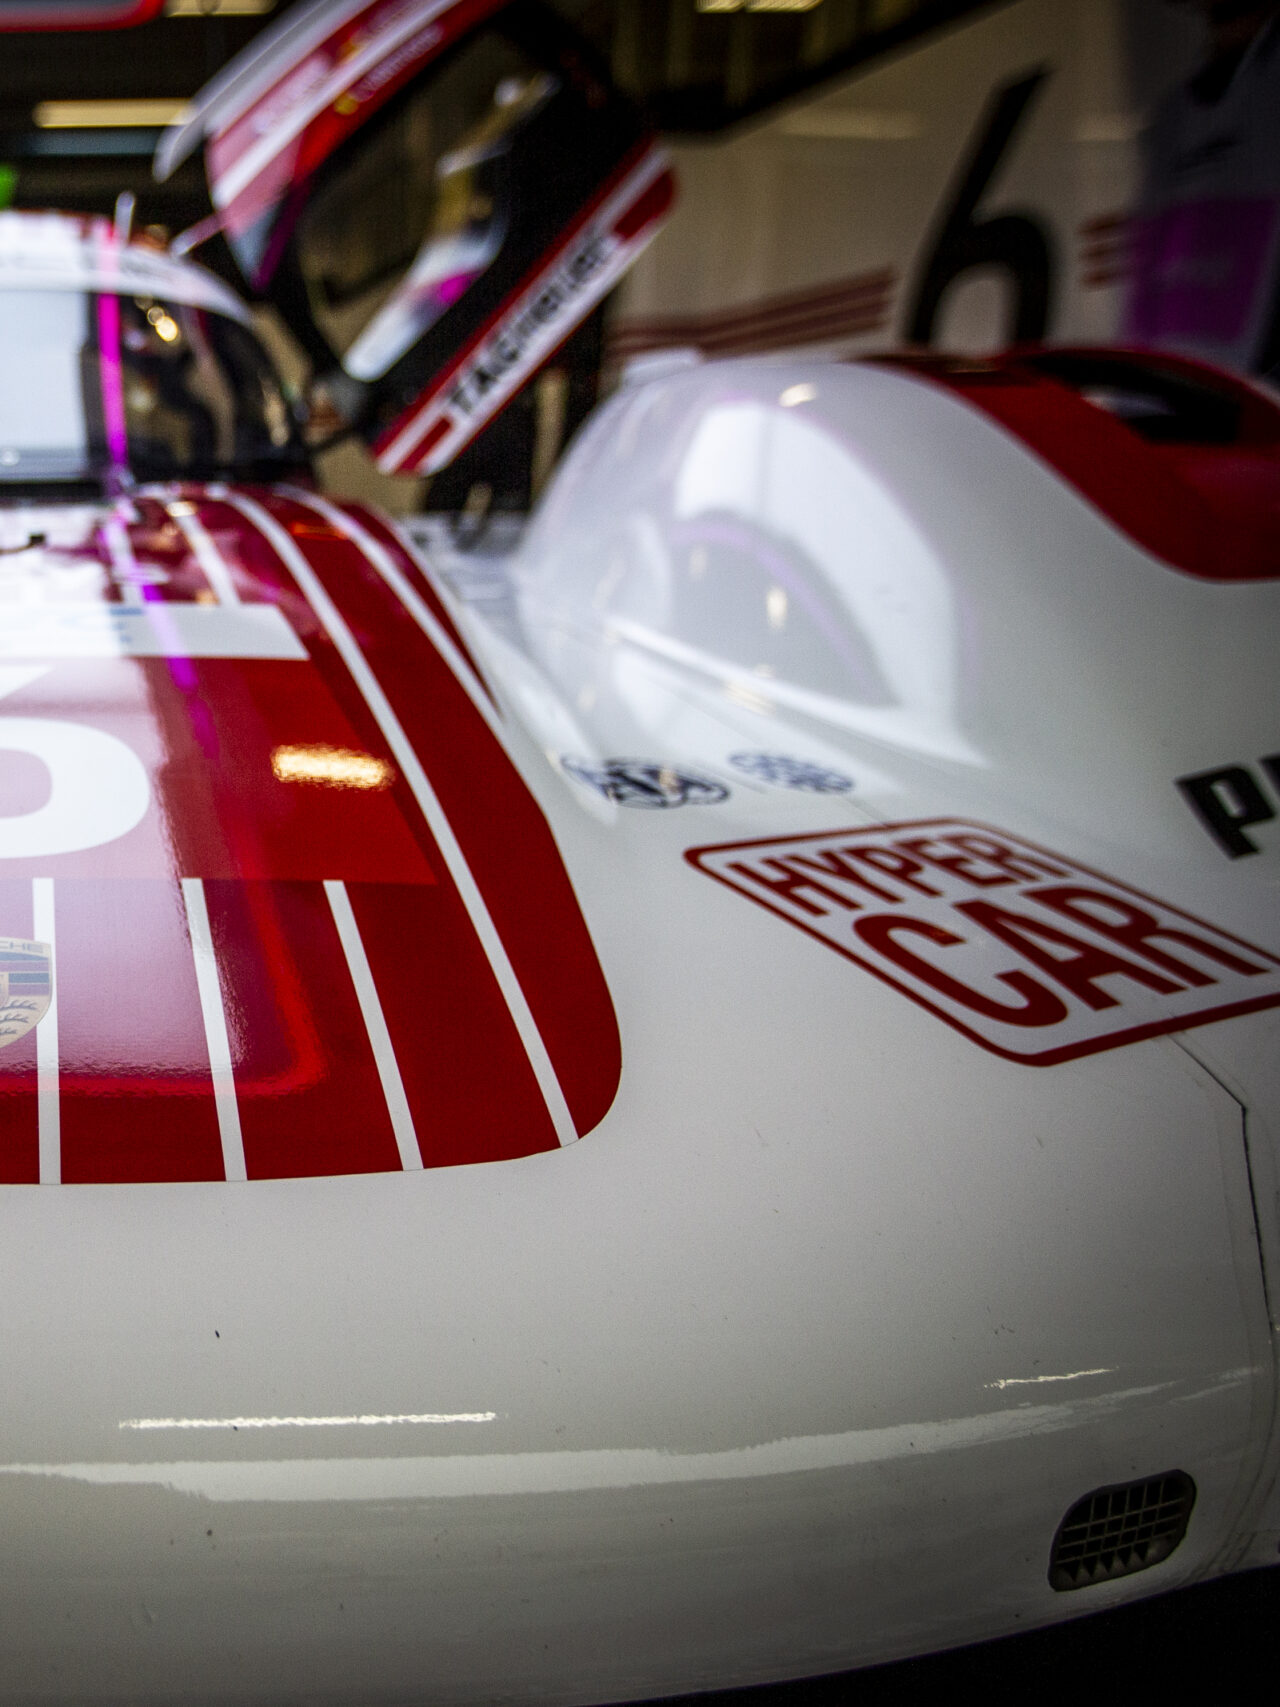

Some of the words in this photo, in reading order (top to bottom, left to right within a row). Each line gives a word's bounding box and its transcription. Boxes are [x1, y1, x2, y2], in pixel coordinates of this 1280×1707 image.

[904, 64, 1053, 350] 6
[1173, 752, 1280, 861] P
[726, 833, 1073, 917] HYPER
[852, 886, 1272, 1028] CAR
